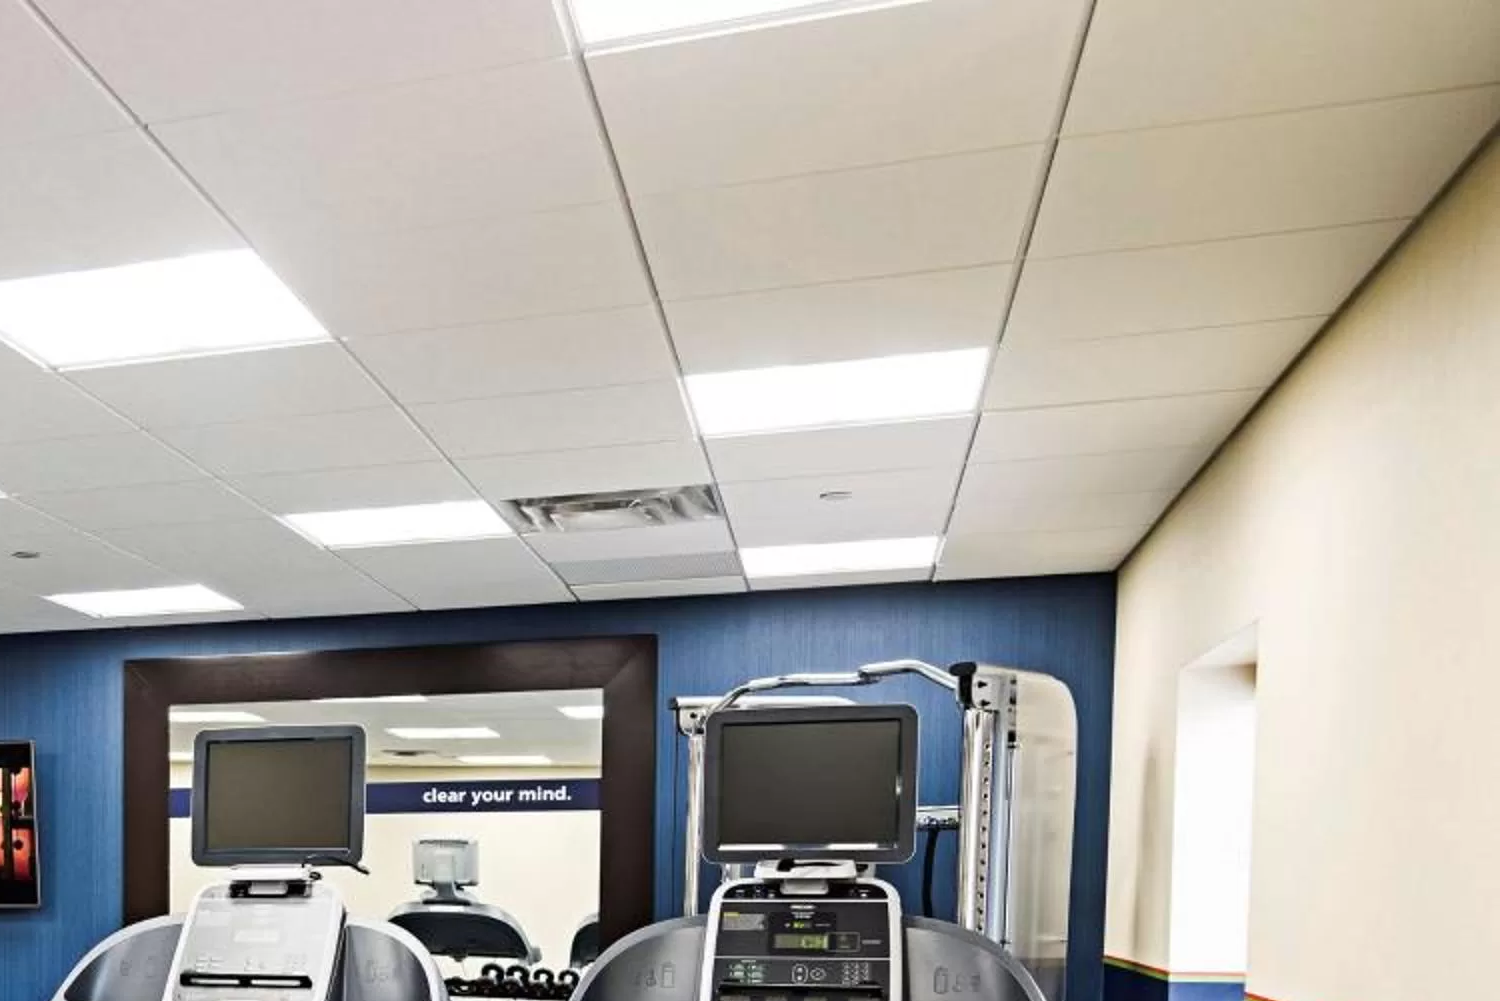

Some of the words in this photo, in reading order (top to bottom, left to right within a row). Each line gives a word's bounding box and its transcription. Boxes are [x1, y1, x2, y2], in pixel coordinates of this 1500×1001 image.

[423, 788, 466, 803] clear
[471, 790, 514, 806] your
[518, 786, 572, 801] mind.
